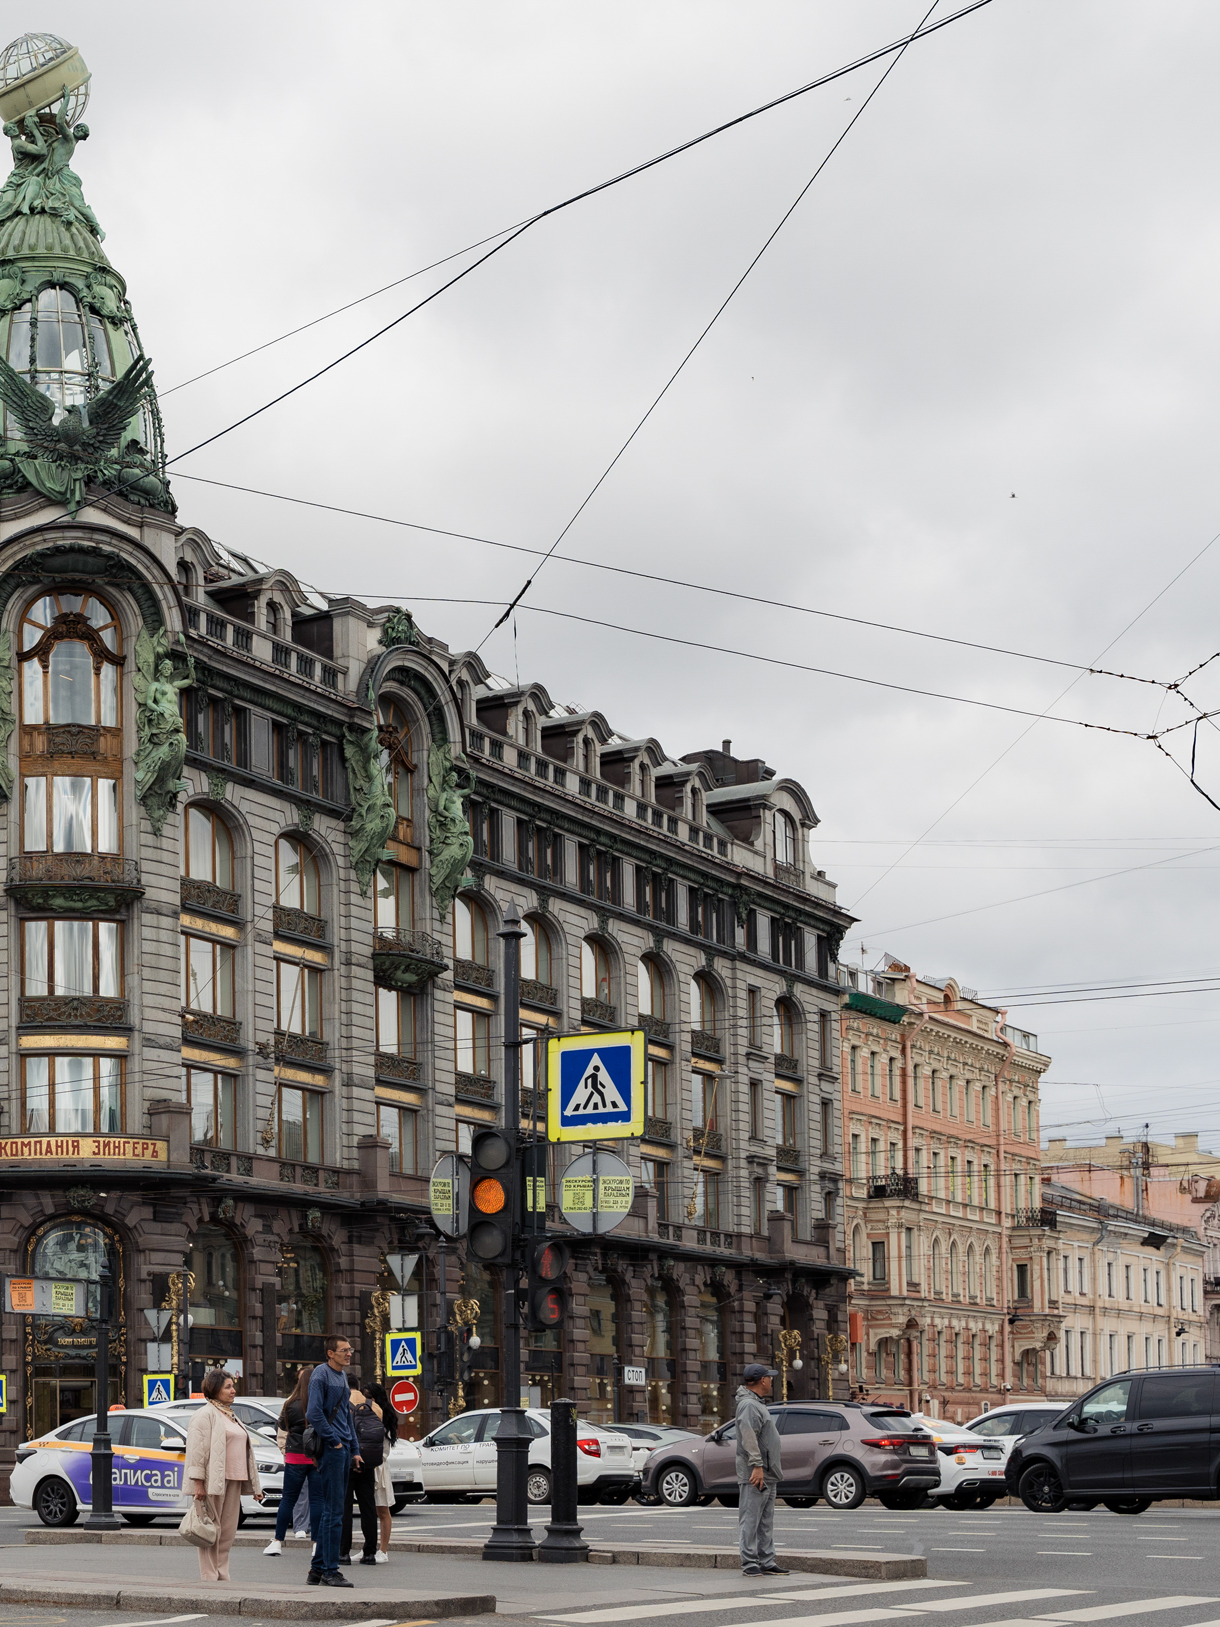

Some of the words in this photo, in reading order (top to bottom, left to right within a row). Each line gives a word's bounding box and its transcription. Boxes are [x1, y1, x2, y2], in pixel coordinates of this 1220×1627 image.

[0, 1140, 80, 1157] КОМПАНІЯ
[92, 1140, 159, 1158] ЗИНГЕРЪ
[547, 1294, 558, 1318] 5
[627, 1369, 643, 1382] СТОП
